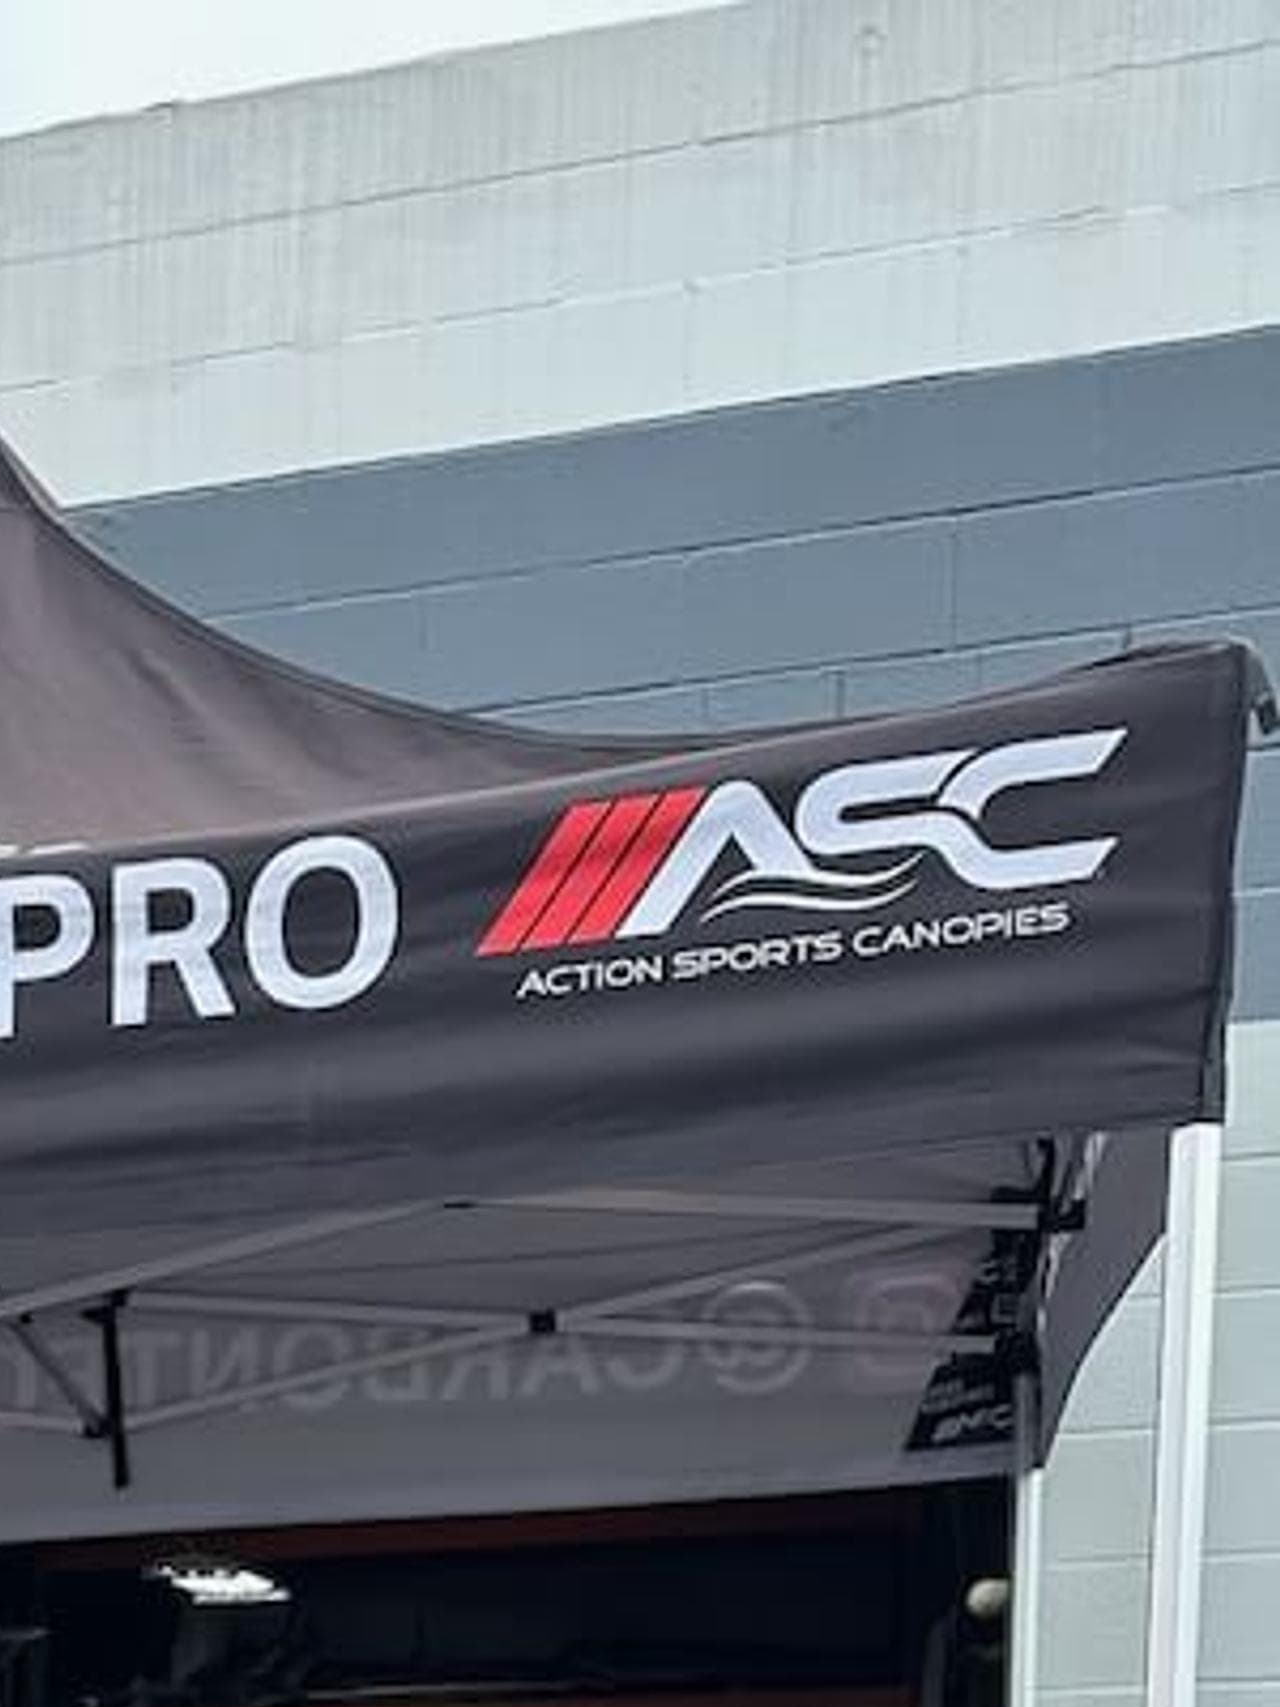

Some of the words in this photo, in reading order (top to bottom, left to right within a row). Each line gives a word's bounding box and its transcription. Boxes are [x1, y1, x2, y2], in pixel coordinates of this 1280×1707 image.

[614, 729, 1128, 938] ASC
[516, 956, 663, 999] ACTION
[672, 930, 842, 980] SPORTS
[852, 902, 1070, 958] CANOPIES
